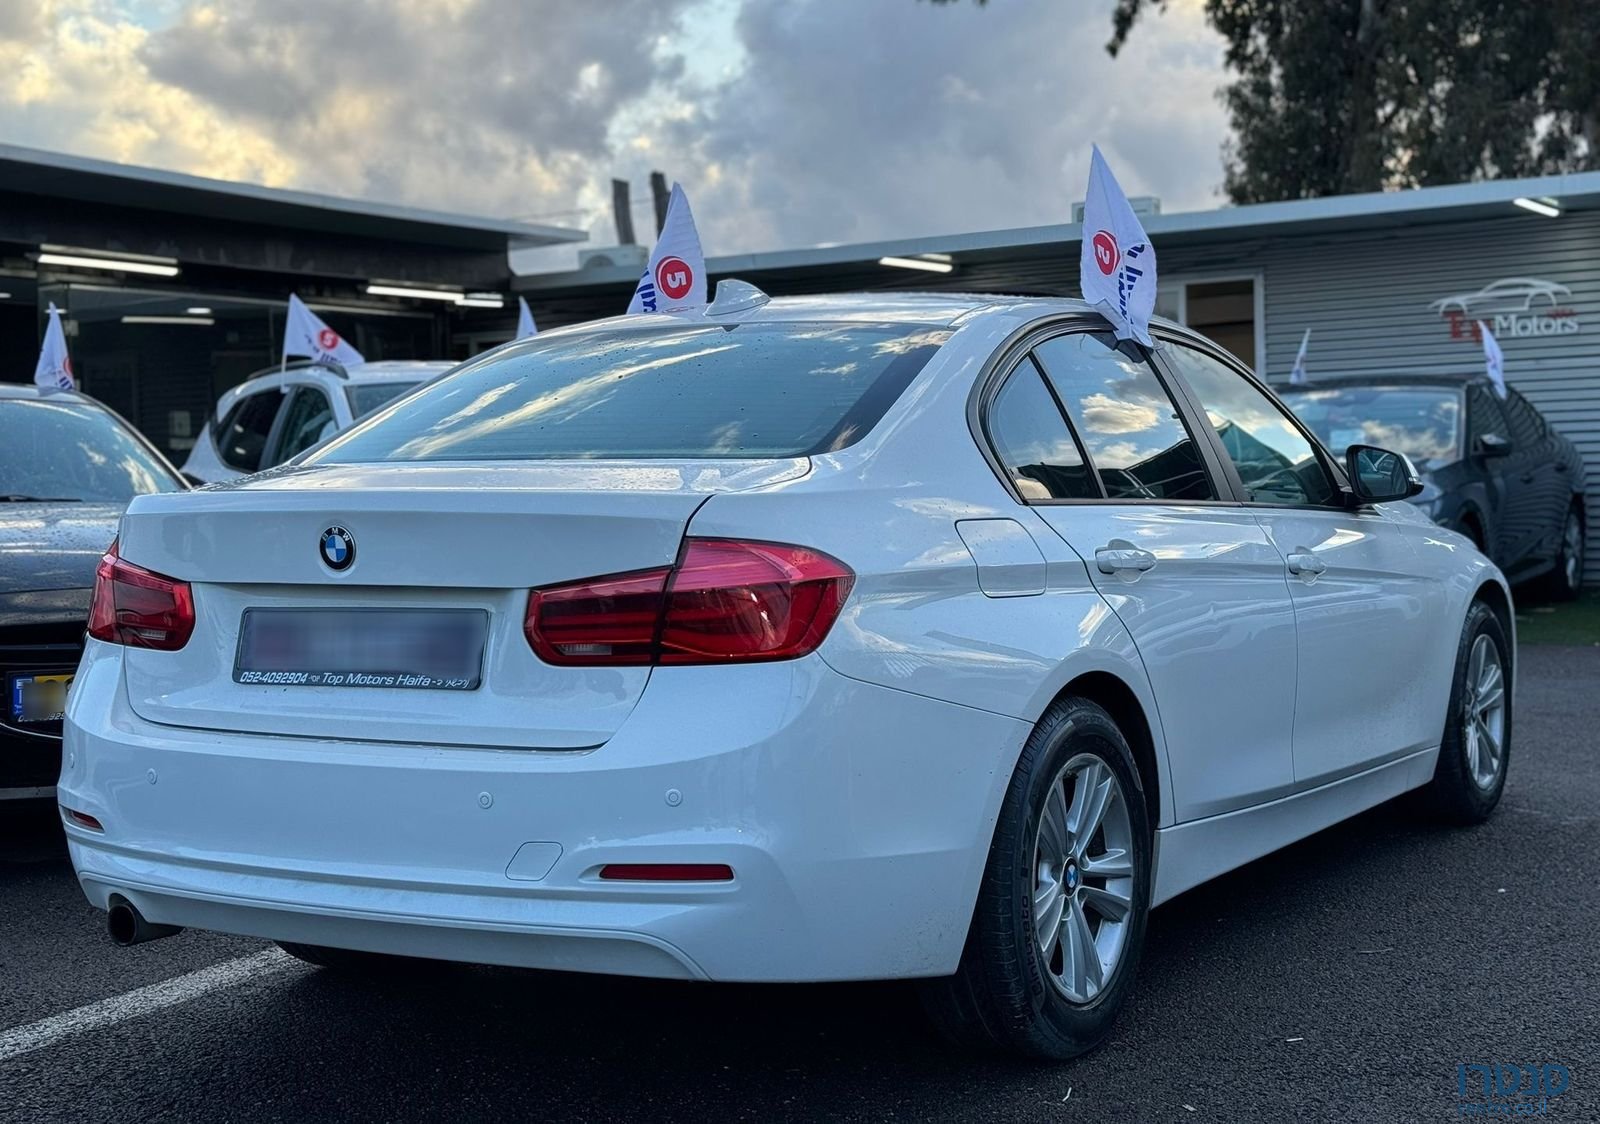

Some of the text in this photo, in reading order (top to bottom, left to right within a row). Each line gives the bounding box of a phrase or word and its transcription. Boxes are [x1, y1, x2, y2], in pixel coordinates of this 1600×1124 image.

[666, 271, 687, 289] 5
[1493, 313, 1580, 338] Motors
[322, 526, 351, 542] BMW
[322, 672, 344, 685] Top
[345, 673, 394, 685] Motors
[395, 674, 432, 687] Haifa
